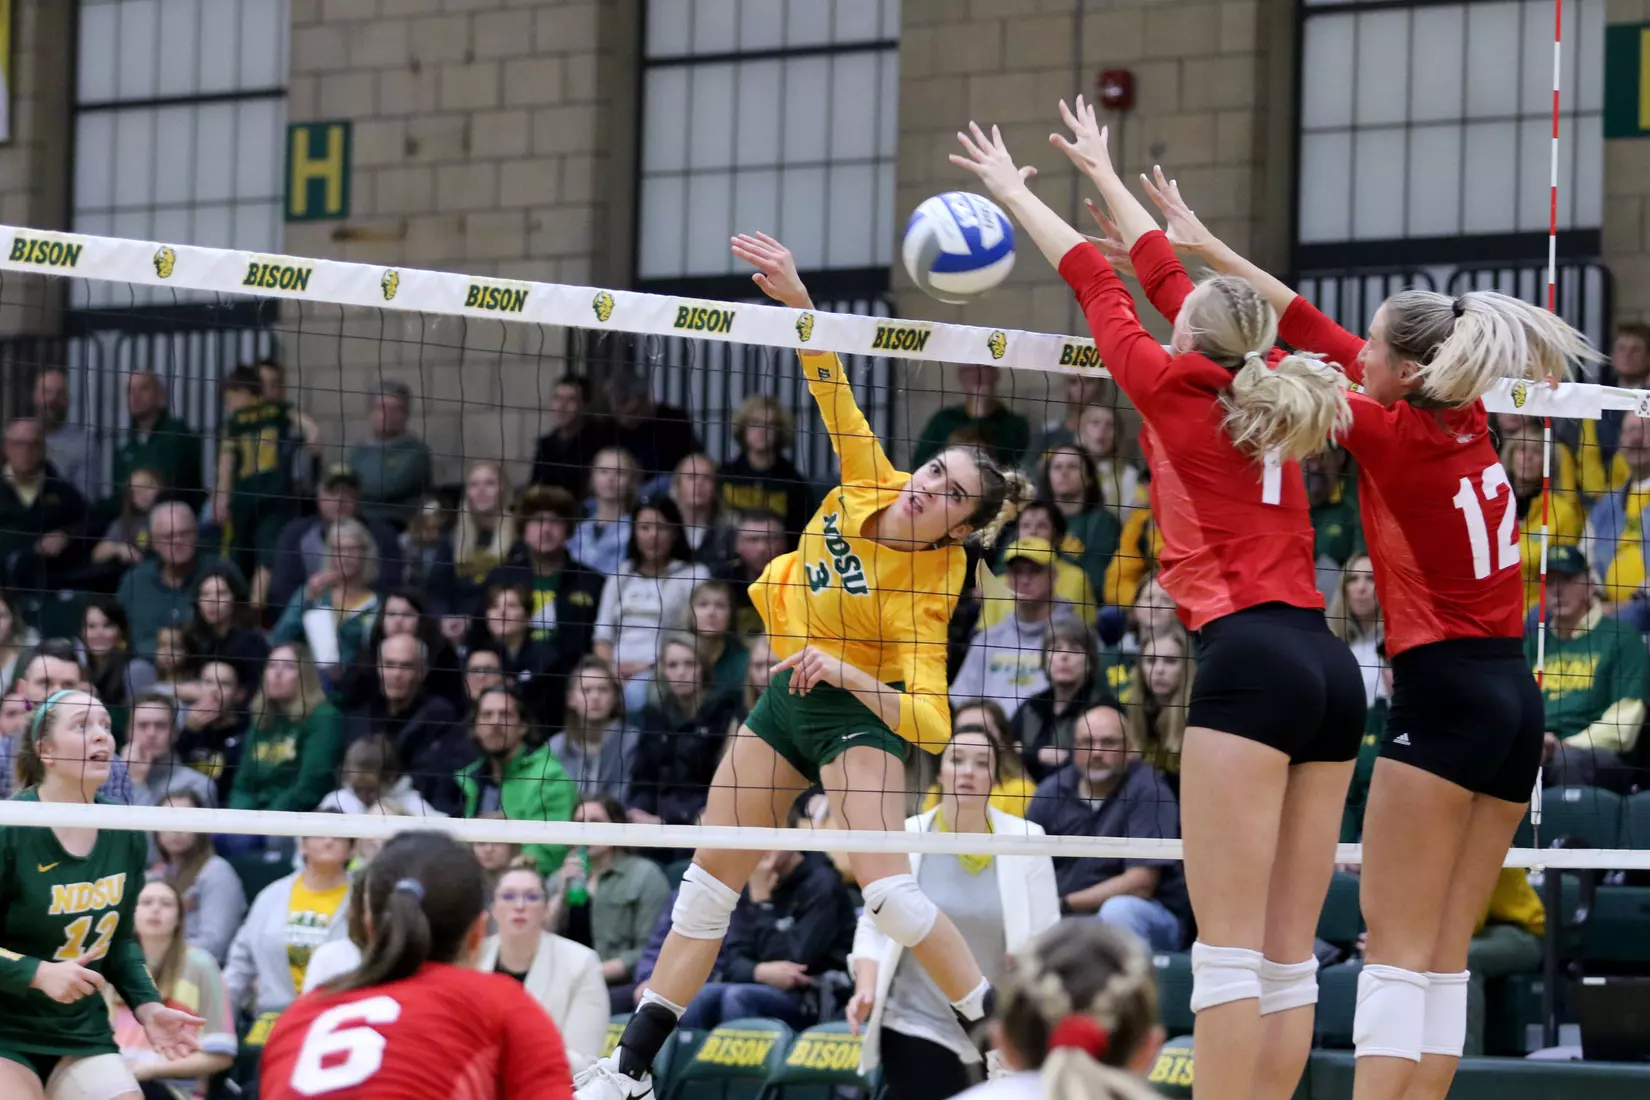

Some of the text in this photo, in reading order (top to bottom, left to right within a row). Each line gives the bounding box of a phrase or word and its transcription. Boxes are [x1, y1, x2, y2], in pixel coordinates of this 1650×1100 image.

[290, 126, 344, 215] H
[9, 237, 82, 268] BISON
[243, 262, 312, 291] BISON
[465, 284, 529, 313] BISON
[674, 304, 736, 334] BISON
[872, 325, 932, 353] BISON
[1059, 343, 1106, 368] BISO
[1453, 462, 1521, 580] 12
[823, 511, 869, 597] NDSU
[804, 558, 833, 597] 3
[48, 872, 127, 915] NDSU
[53, 910, 120, 961] 12
[291, 995, 401, 1096] 6
[696, 1036, 776, 1066] BISON
[786, 1040, 862, 1071] BISON
[1148, 1055, 1194, 1086] BIS
